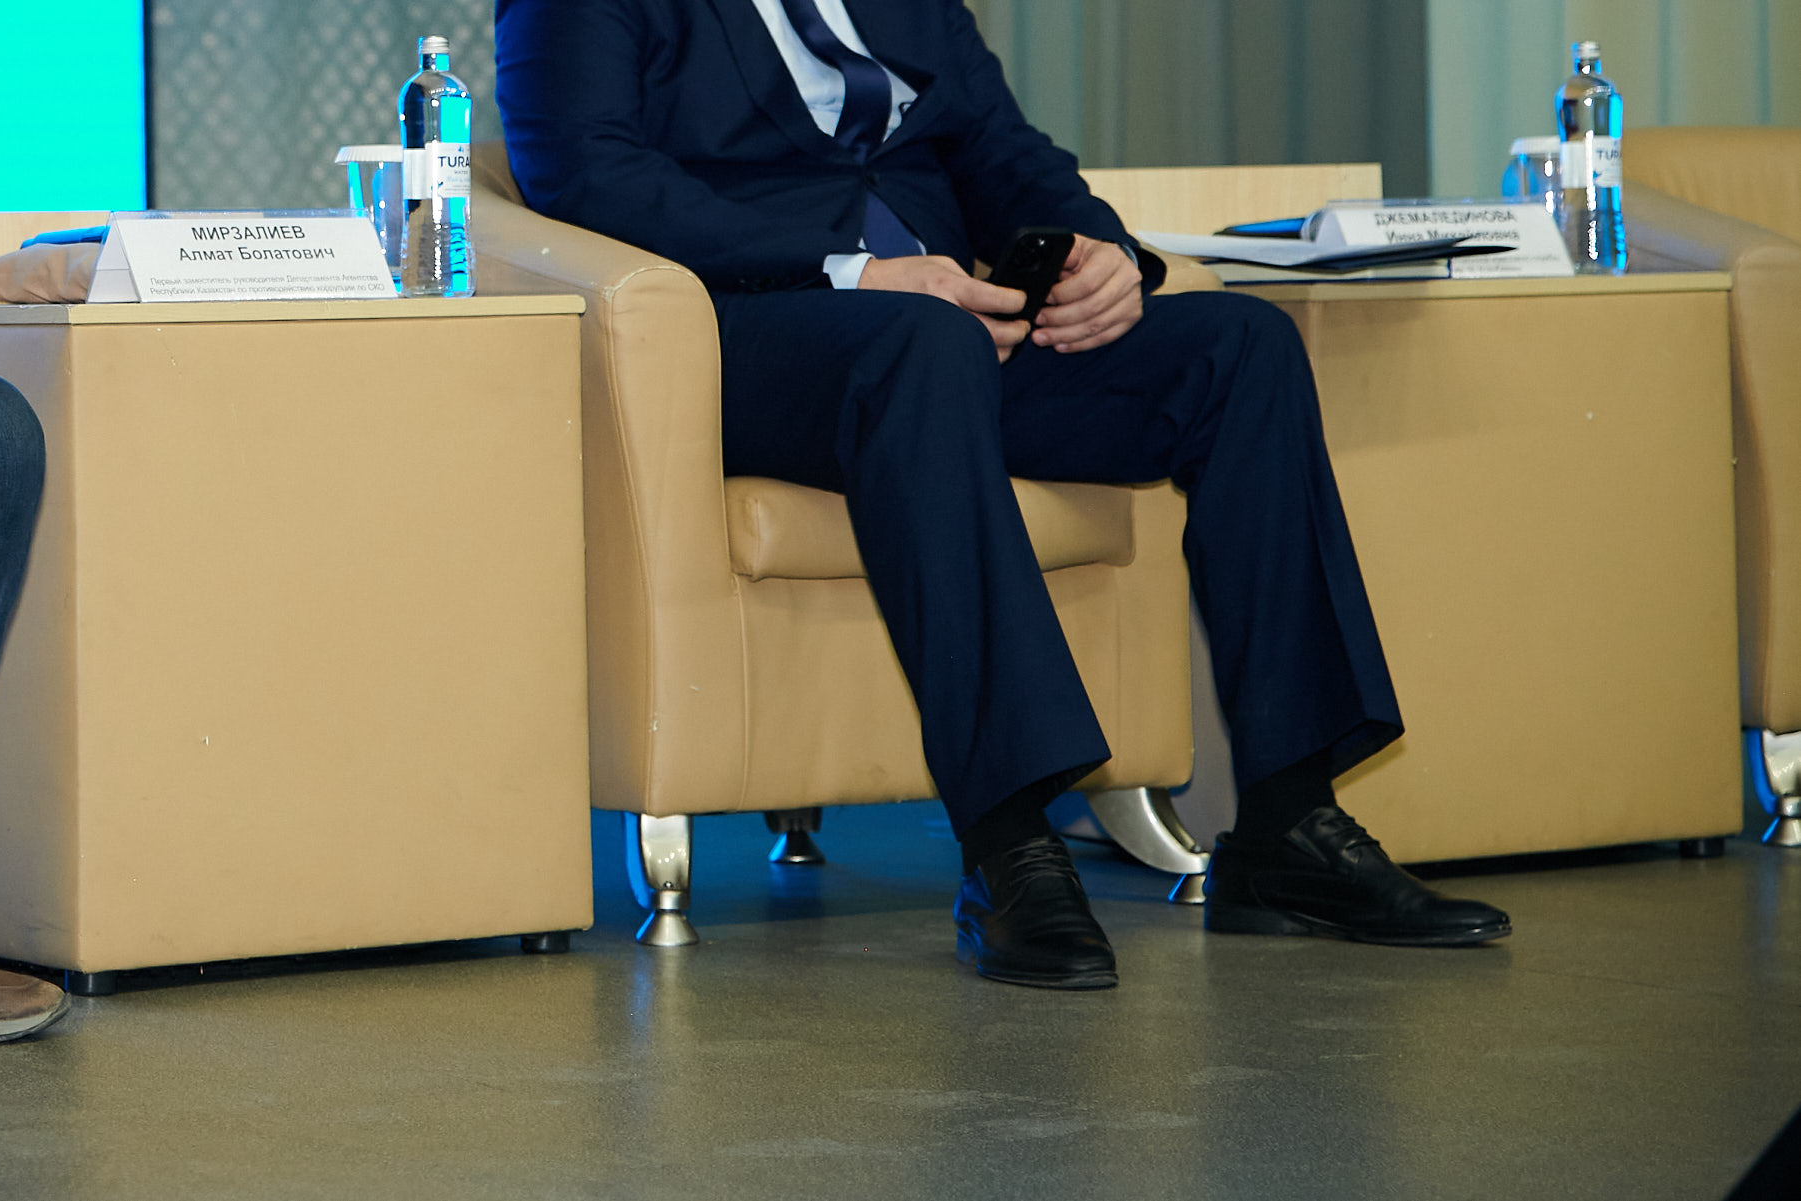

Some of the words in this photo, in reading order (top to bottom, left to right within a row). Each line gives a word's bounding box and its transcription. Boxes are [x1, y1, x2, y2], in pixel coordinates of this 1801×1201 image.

[1373, 209, 1518, 227] ДЖЕМАЛЕДИНОВА
[191, 225, 306, 241] МИРЗАЛИЕВ
[179, 247, 234, 262] Алмат
[239, 246, 336, 261] Болатович
